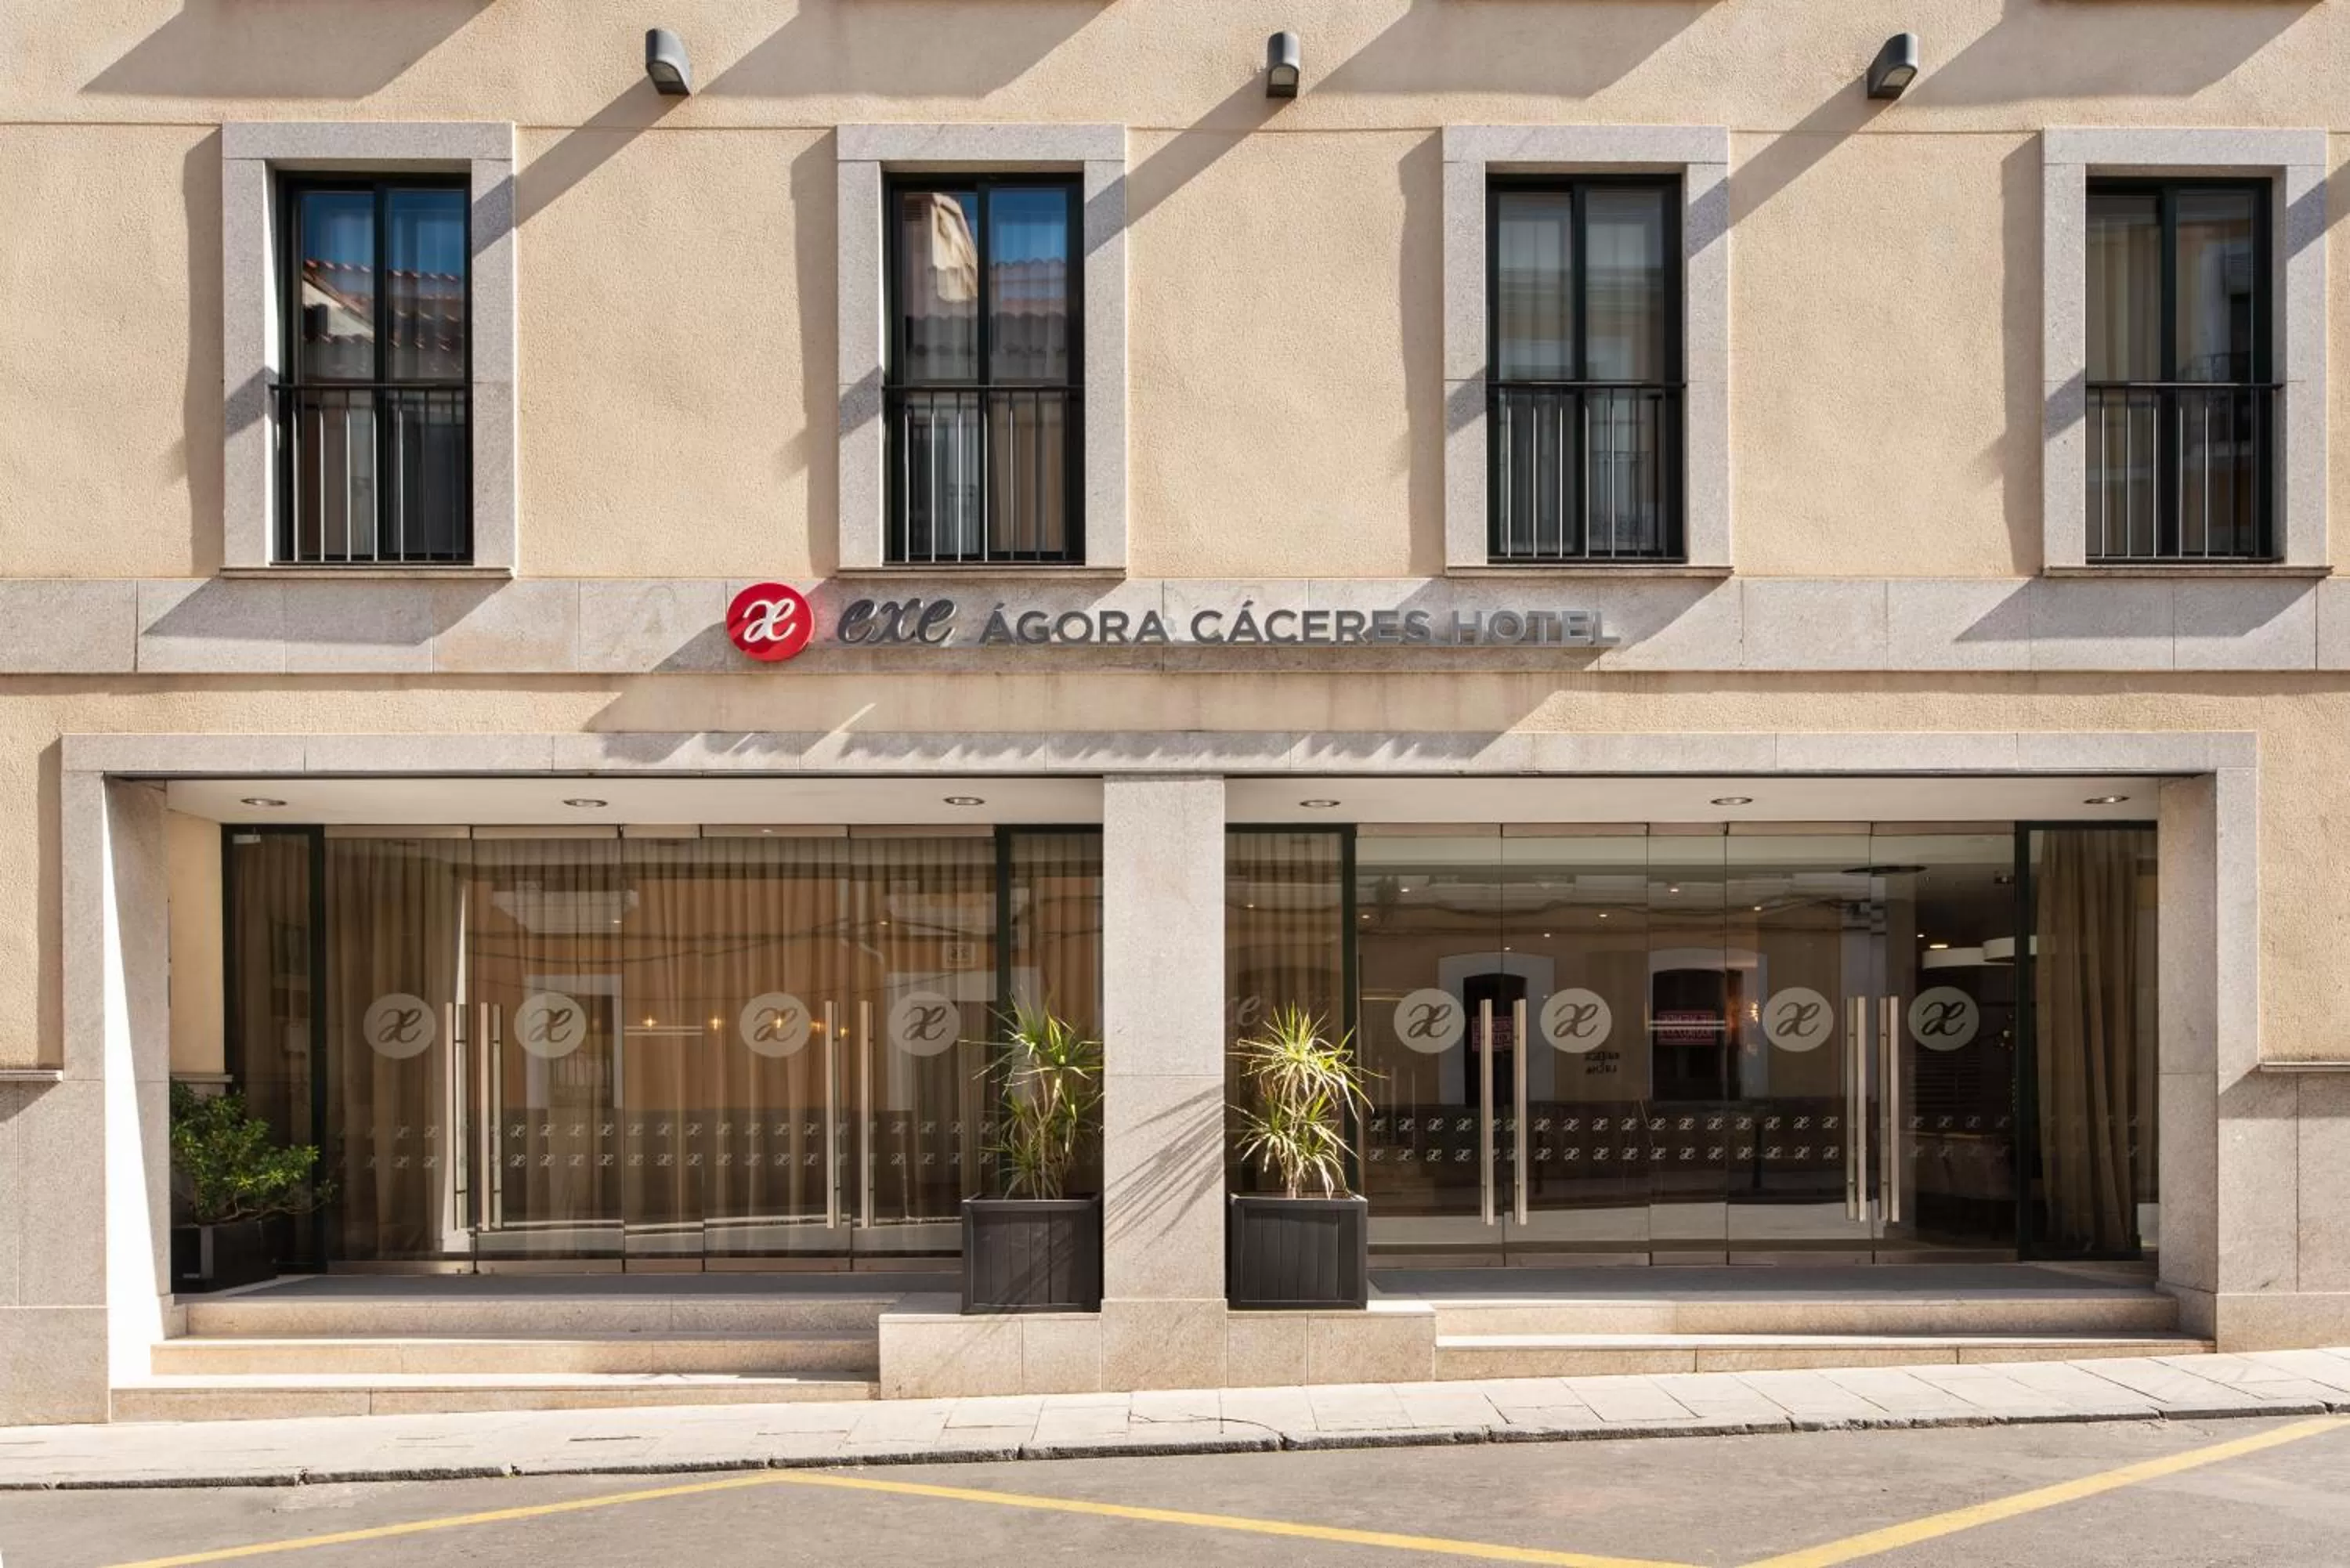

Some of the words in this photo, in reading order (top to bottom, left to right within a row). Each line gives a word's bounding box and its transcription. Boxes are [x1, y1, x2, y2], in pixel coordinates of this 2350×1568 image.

[837, 598, 956, 645] exe
[979, 602, 1172, 645] ÁGORA
[1190, 599, 1432, 645] CÁCERES
[1452, 609, 1622, 645] HOTEL
